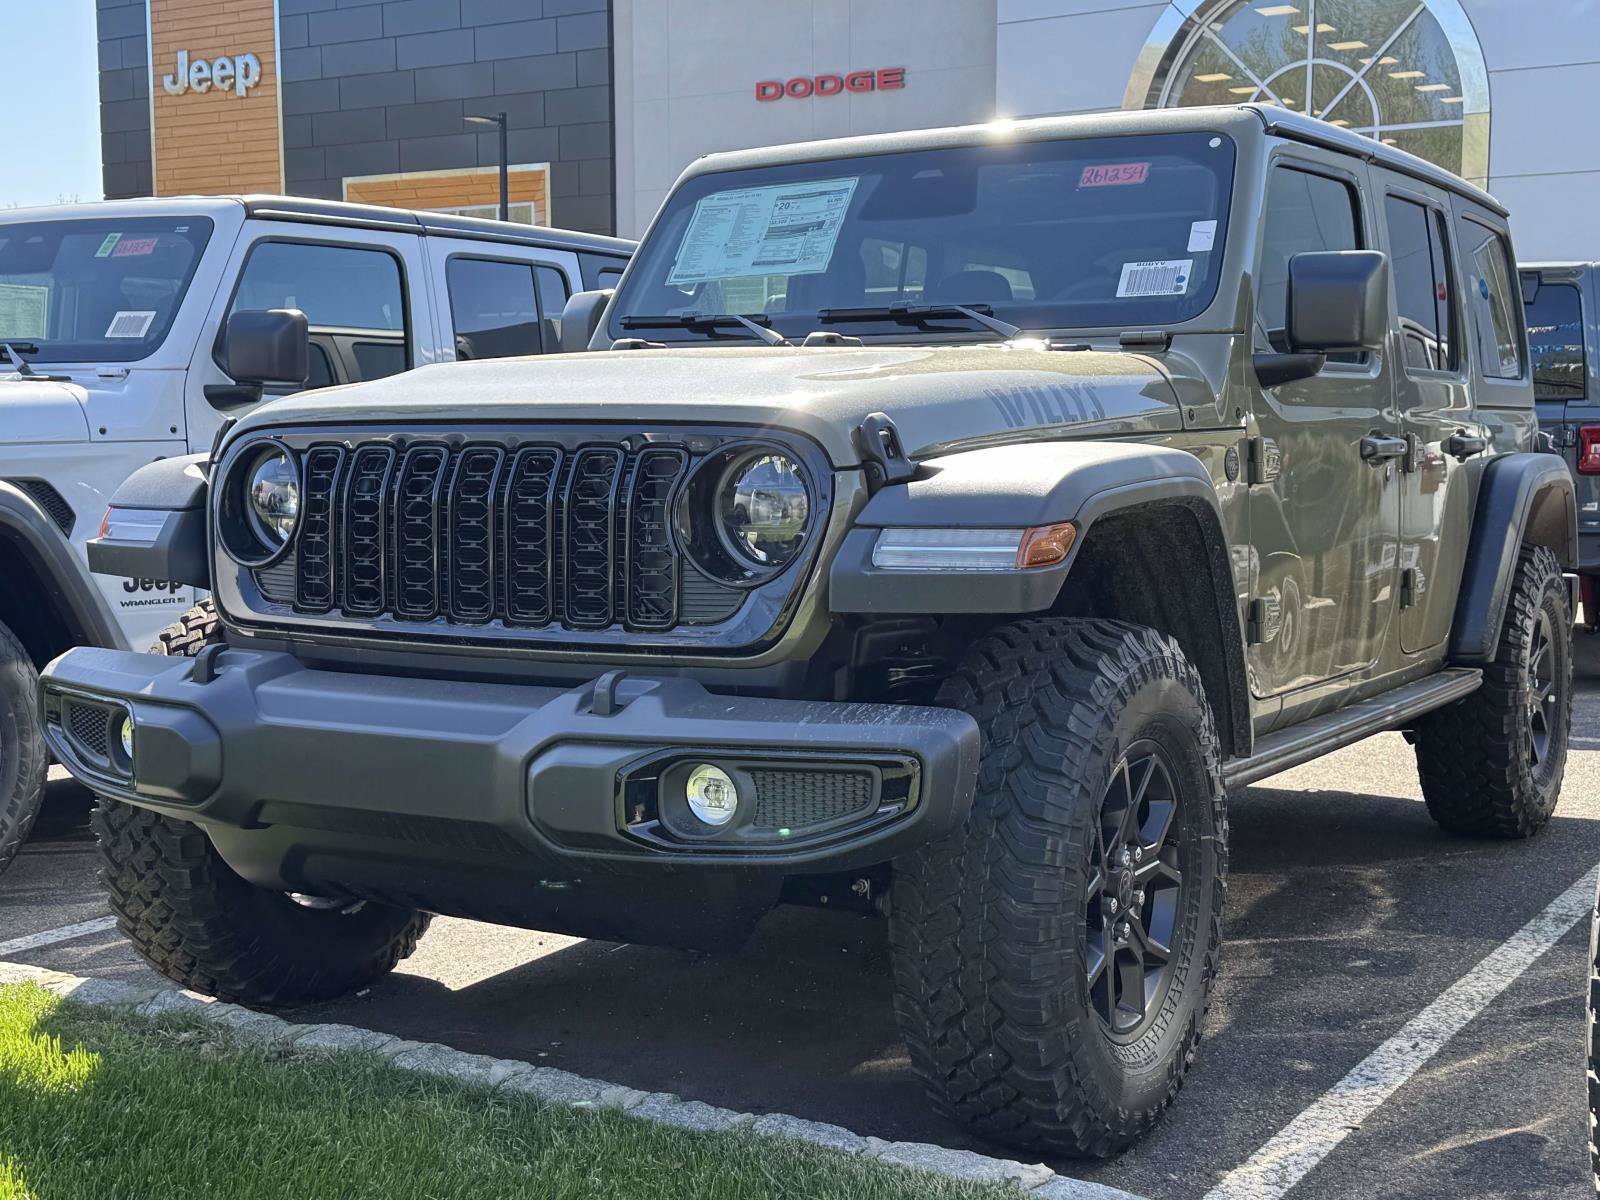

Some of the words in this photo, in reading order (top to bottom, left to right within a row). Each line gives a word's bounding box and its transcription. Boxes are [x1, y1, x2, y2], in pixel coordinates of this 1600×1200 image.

[163, 50, 261, 97] Jeep
[756, 67, 905, 101] DODGE
[983, 383, 1105, 427] WILLYS
[120, 597, 175, 607] WRANGLER
[123, 577, 184, 595] Jeep
